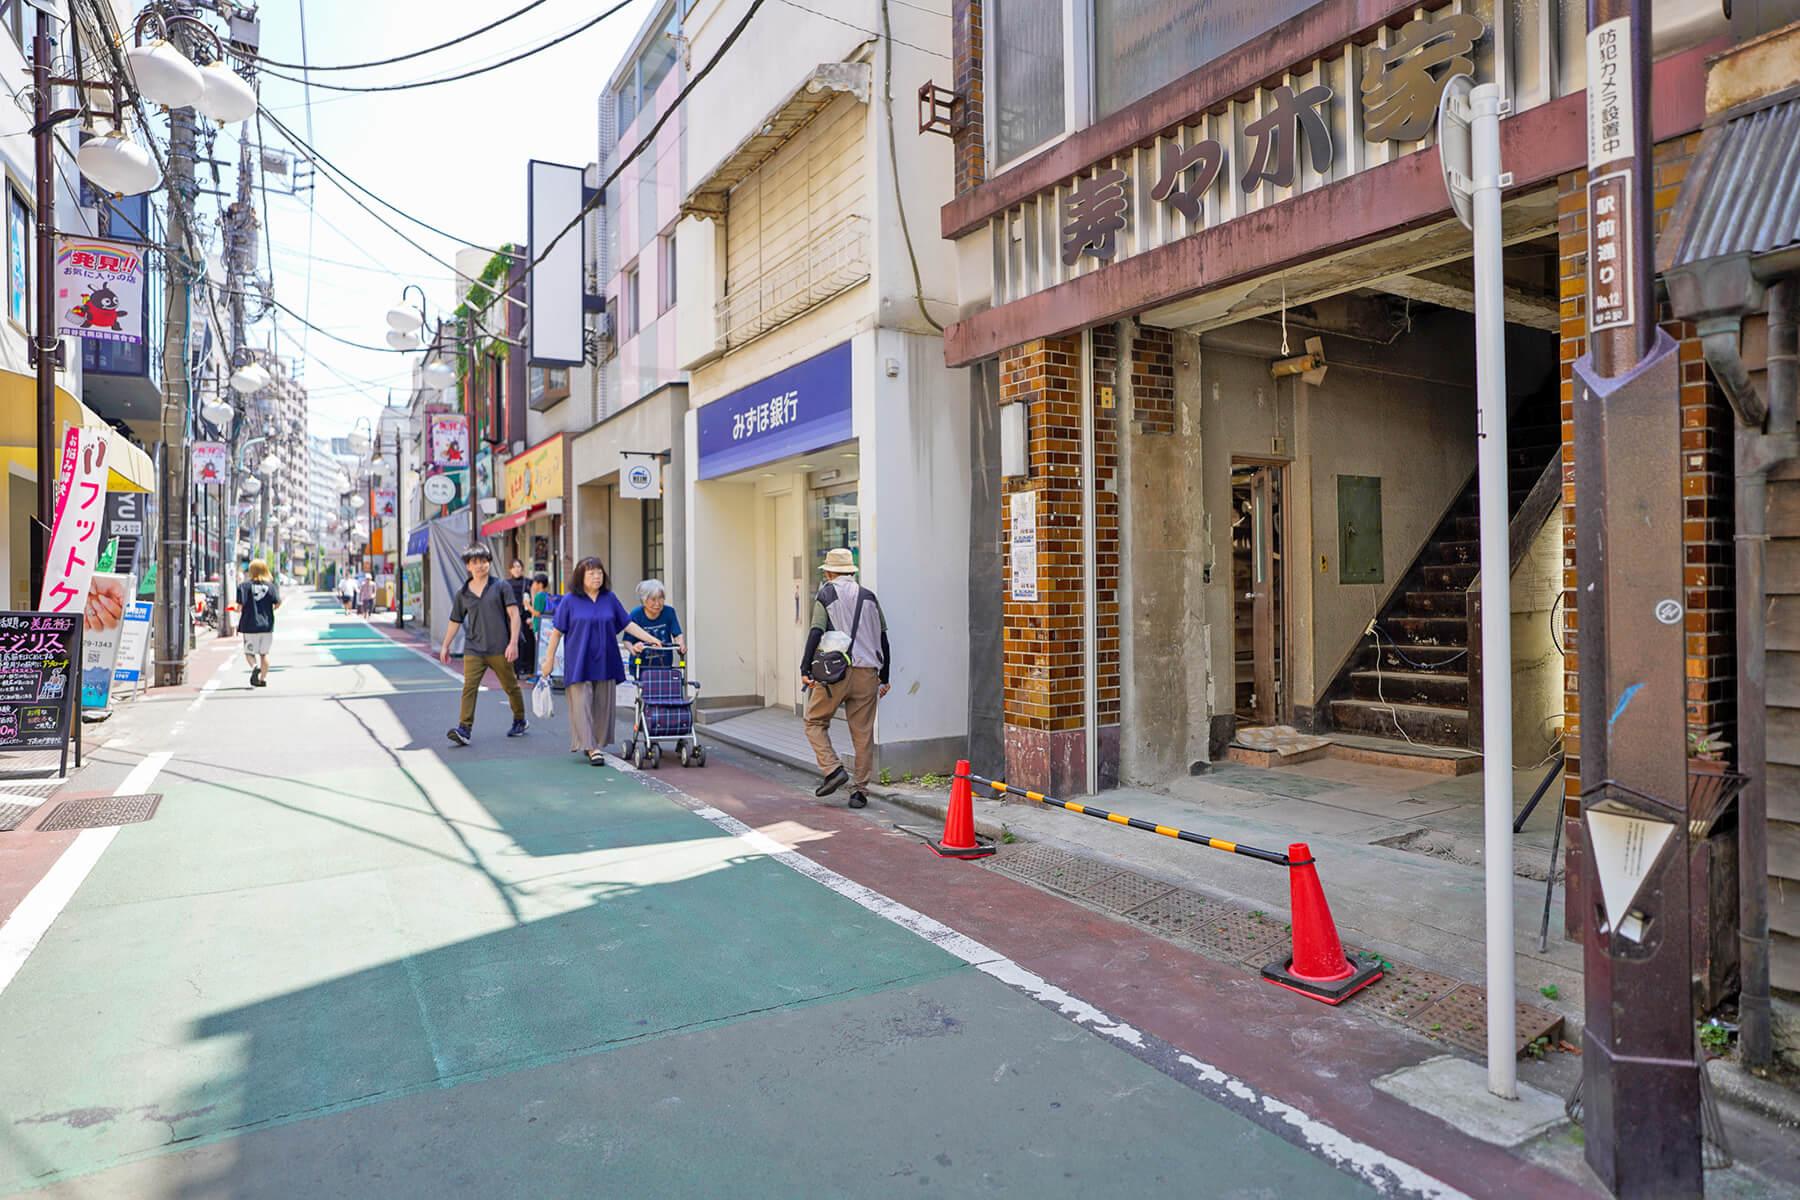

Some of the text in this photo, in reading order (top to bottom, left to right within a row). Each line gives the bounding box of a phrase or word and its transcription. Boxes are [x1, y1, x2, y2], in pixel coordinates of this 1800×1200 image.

[1062, 14, 1485, 267] 寿々木家
[1599, 29, 1621, 153] 防犯カメラ設置中
[63, 267, 137, 285] お気に入りの店
[1596, 196, 1616, 284] 駅前通り
[732, 390, 799, 441] みずほ銀行
[49, 481, 100, 612] フットケ
